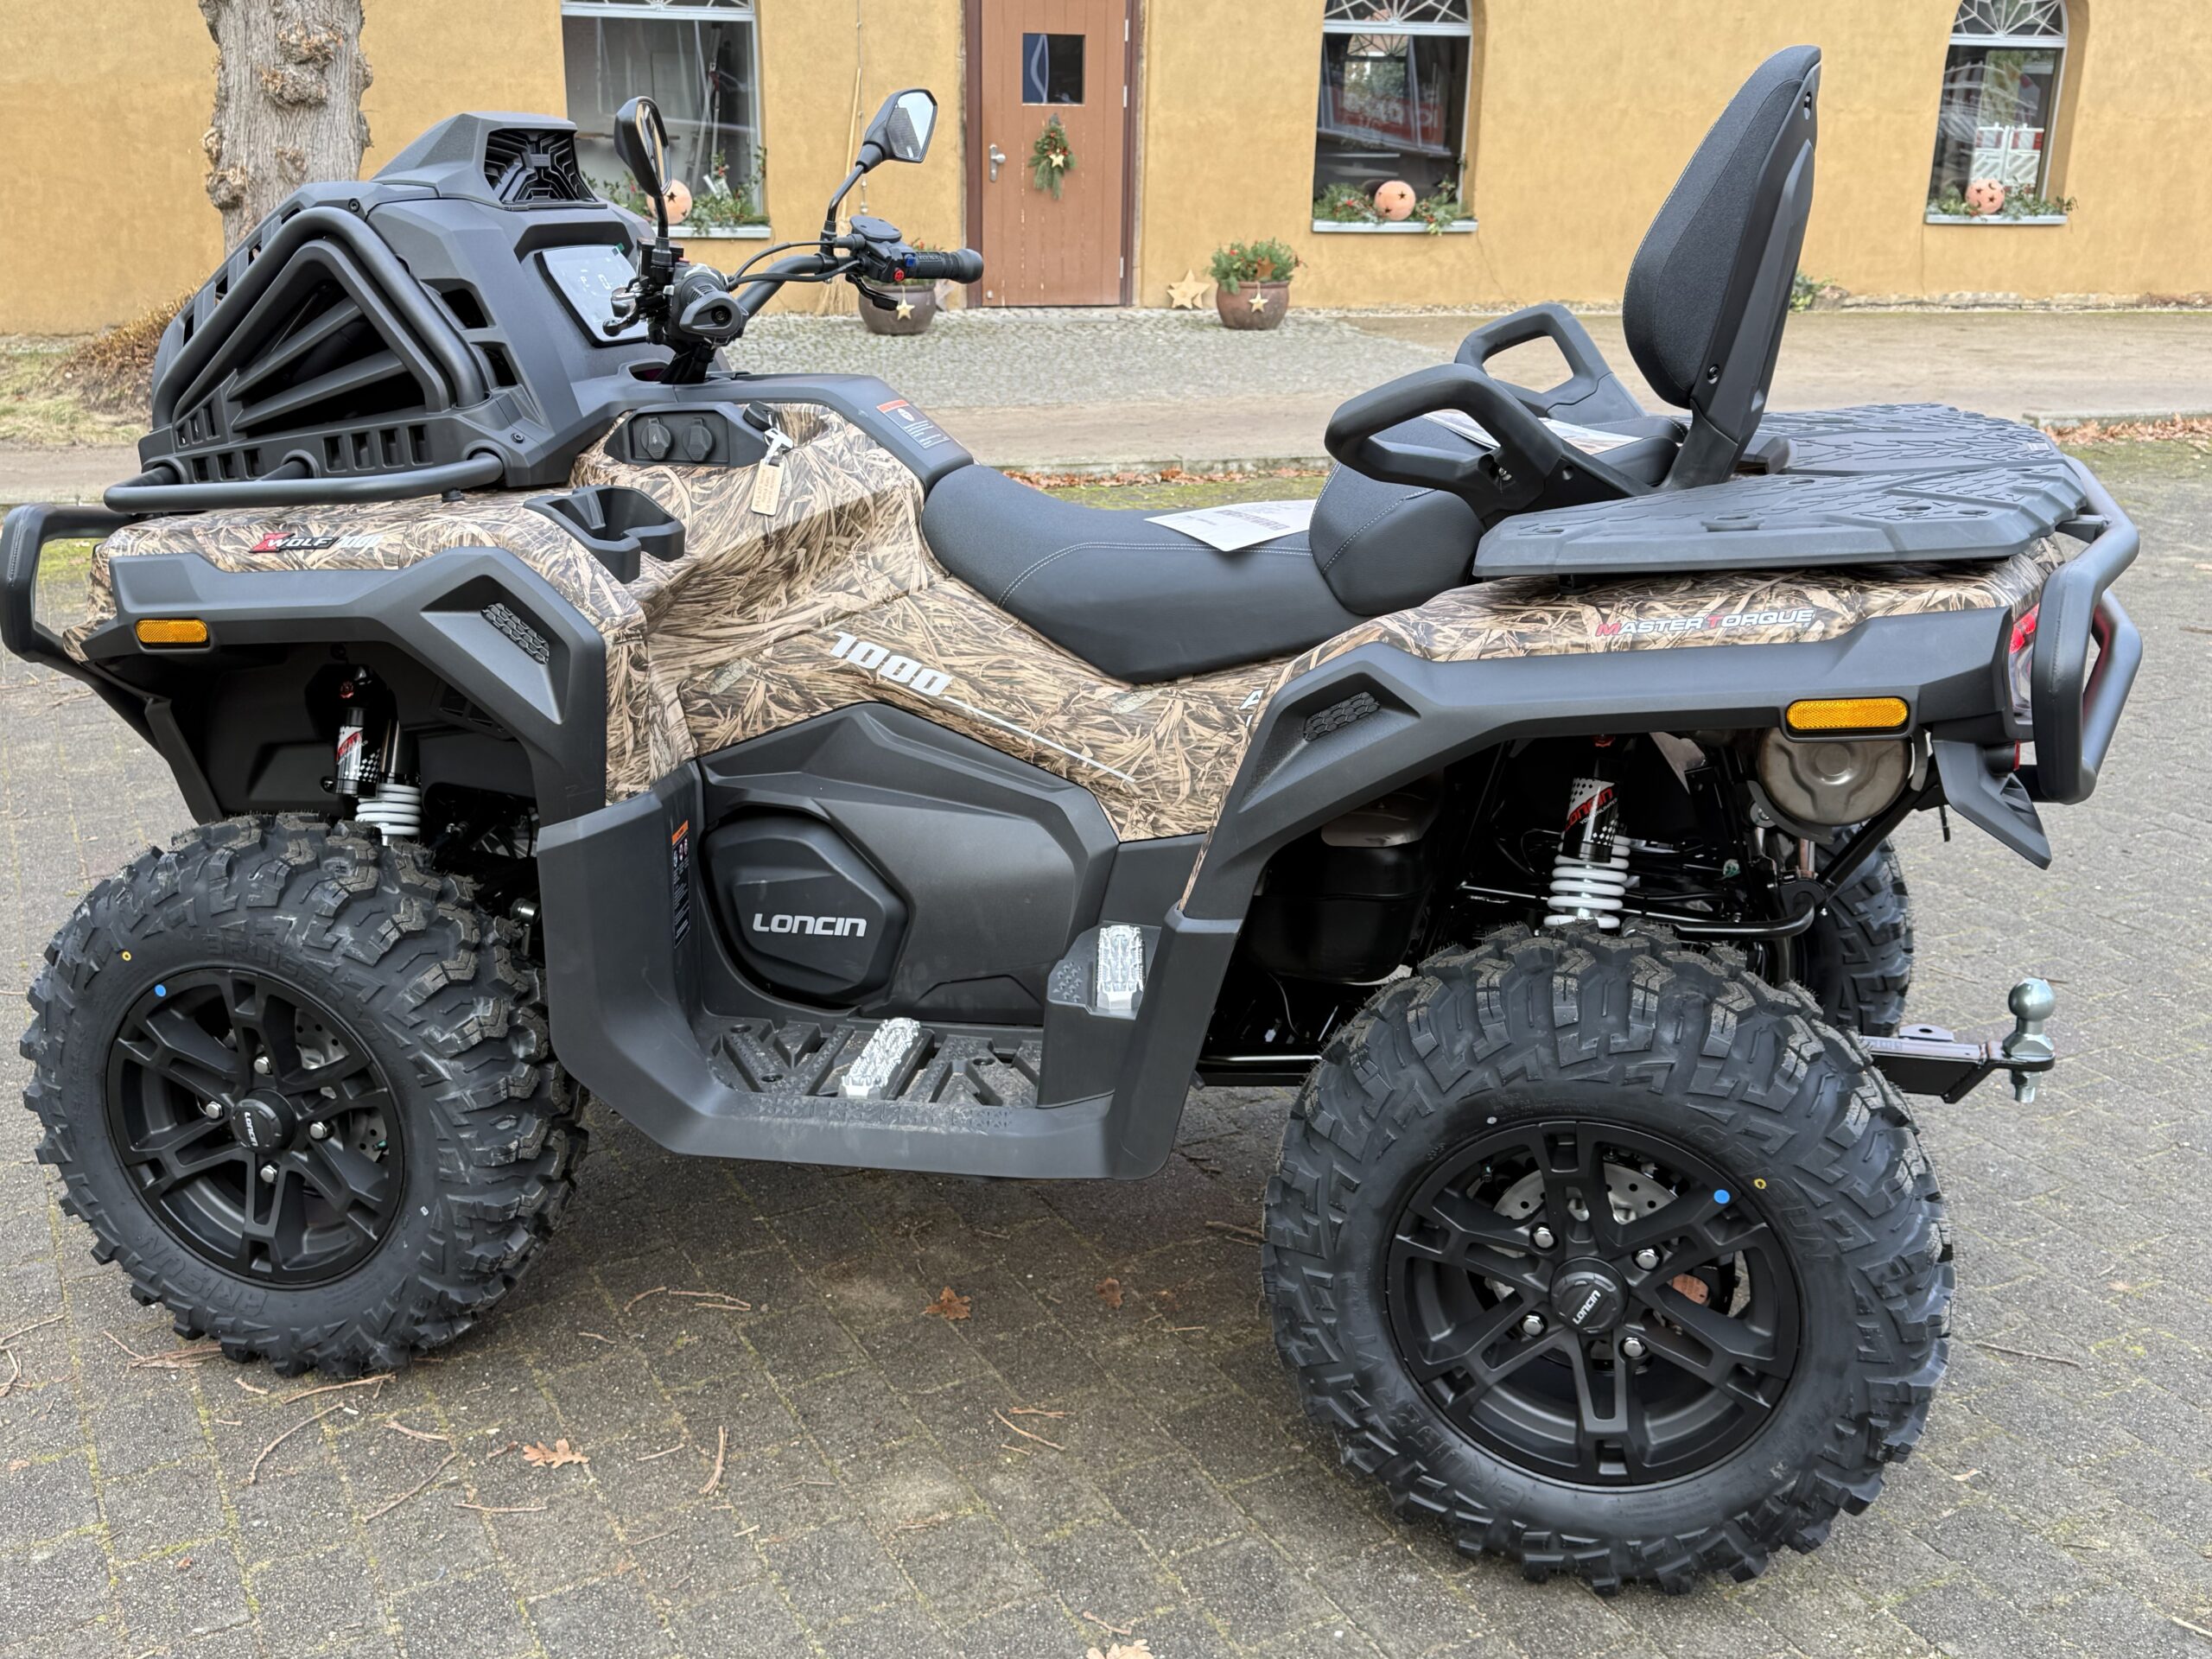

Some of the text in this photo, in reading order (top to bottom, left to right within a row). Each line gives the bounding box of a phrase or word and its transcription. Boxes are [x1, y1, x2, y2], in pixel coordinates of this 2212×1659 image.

[1595, 609, 1815, 638] MASTER TORQUE
[830, 631, 953, 696] 1000
[753, 912, 868, 938] LONCIN
[244, 1111, 259, 1147] LONCIN
[1572, 1289, 1601, 1325] LONCIN
